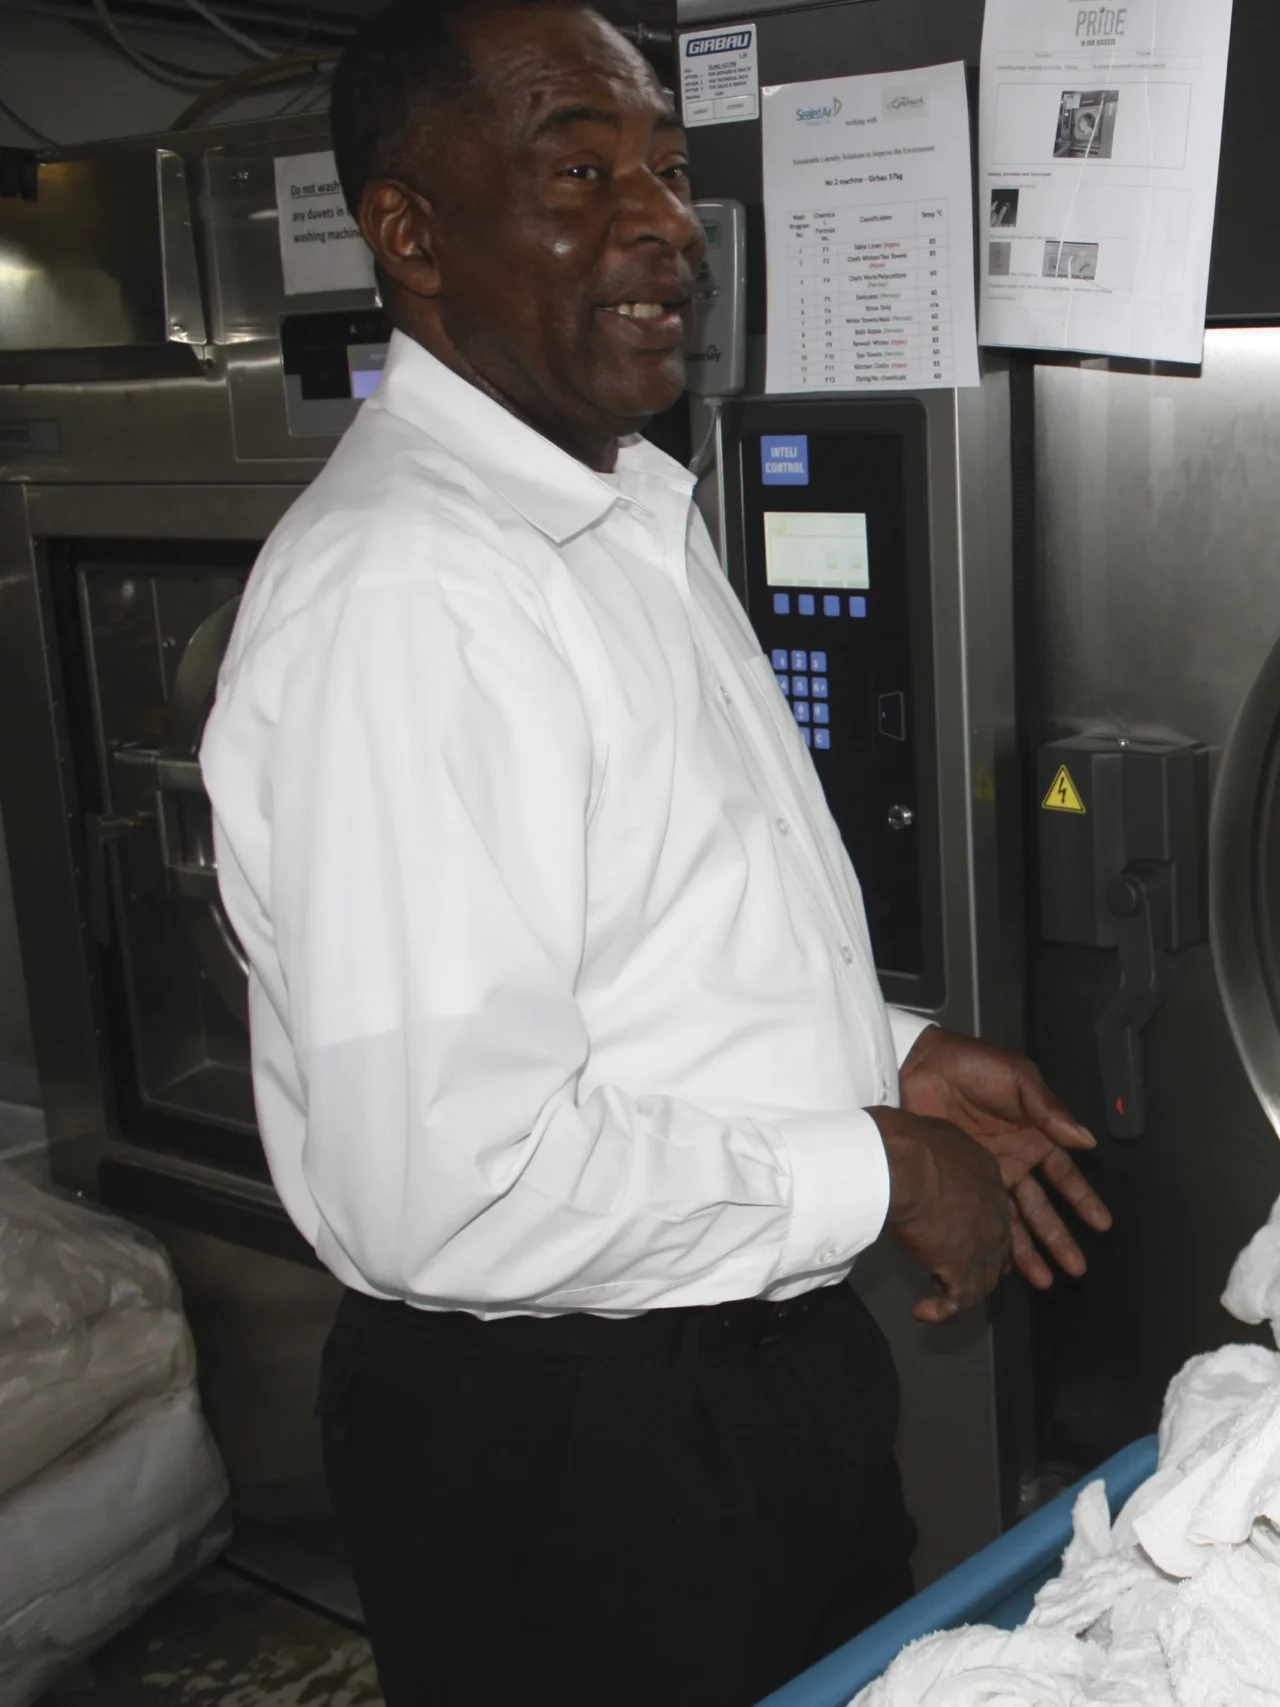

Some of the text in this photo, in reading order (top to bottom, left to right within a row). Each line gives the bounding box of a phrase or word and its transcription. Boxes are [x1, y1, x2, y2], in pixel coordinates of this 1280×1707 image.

[1075, 6, 1127, 37] PRIDE
[688, 33, 749, 54] GIRBAU
[1096, 38, 1117, 46] SUCCESS
[796, 106, 822, 121] Sealed
[842, 152, 866, 162] Solutions
[902, 145, 935, 155] Environment
[834, 178, 838, 186] 2
[839, 176, 863, 185] machine
[868, 174, 888, 184] Girbau
[290, 180, 340, 196] Do not wash
[292, 210, 306, 223] any
[307, 207, 336, 220] duvets
[336, 205, 345, 217] in
[859, 213, 893, 223] Classification
[921, 210, 936, 219] Temp
[293, 229, 327, 244] washing
[880, 304, 892, 312] Only
[879, 373, 907, 382] chemicals
[770, 446, 798, 459] INTELI
[765, 461, 805, 475] CONTROL
